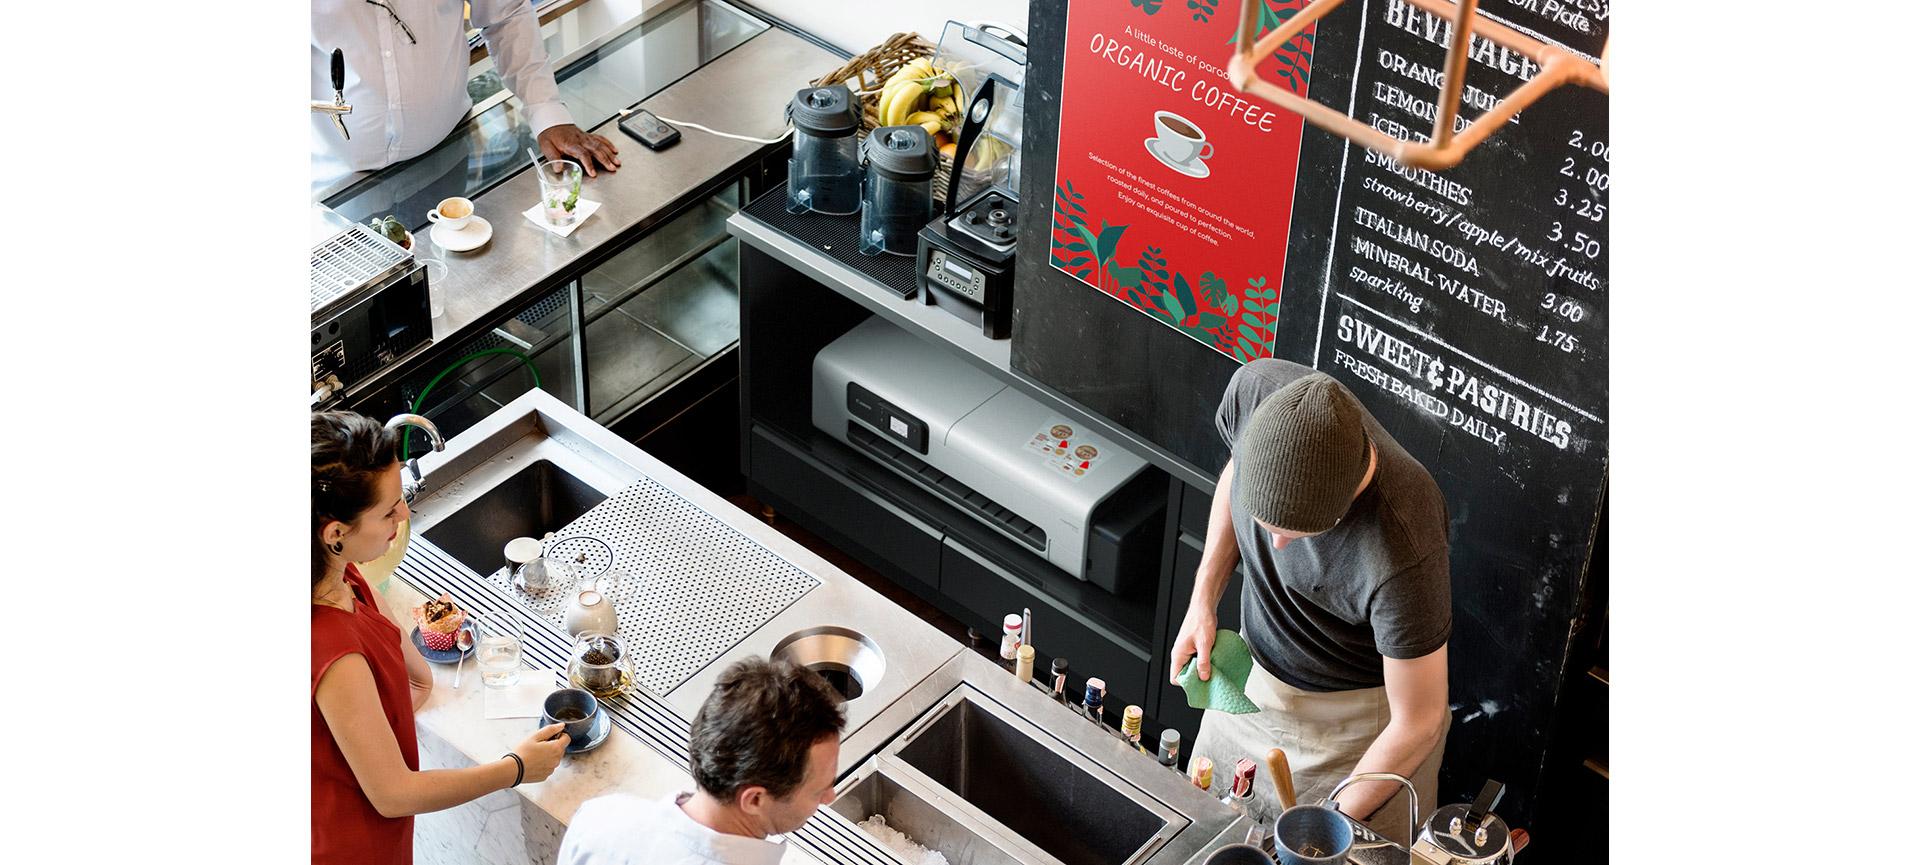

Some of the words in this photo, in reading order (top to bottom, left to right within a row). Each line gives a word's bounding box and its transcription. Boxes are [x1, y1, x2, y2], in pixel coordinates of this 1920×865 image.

[1386, 0, 1541, 82] BEVAGE
[1541, 0, 1590, 32] Plate
[1125, 25, 1133, 36] A
[1134, 28, 1156, 47] little
[1158, 41, 1184, 60] taste
[1186, 55, 1198, 65] of
[1198, 61, 1231, 81] parad
[1379, 50, 1447, 90] ORANG
[1089, 33, 1186, 92] ORGANIC
[1191, 80, 1276, 132] COFFEE
[1374, 82, 1476, 134] LEMOND
[1370, 113, 1409, 142] ICED
[1088, 152, 1118, 172] Selection
[1119, 167, 1126, 175] of
[1126, 170, 1138, 182] the
[1138, 176, 1156, 190] finest
[1156, 185, 1180, 202] coffees
[1181, 197, 1197, 210] from
[1197, 206, 1222, 223] around
[1223, 217, 1235, 229] the
[1364, 147, 1473, 206] SMOOTHIES
[1559, 157, 1609, 191] 2.00
[1107, 174, 1133, 191] roasted
[1133, 186, 1150, 201] daily,
[1151, 196, 1164, 207] and
[1164, 203, 1189, 219] poured
[1189, 214, 1197, 223] to
[1197, 219, 1233, 241] perfection.
[1118, 191, 1136, 208] Enjoy
[1136, 202, 1146, 210] an
[1146, 206, 1175, 225] exquisite
[1176, 221, 1188, 231] cup
[1189, 226, 1197, 235] of
[1197, 230, 1219, 247] coffee.
[1553, 188, 1607, 222] 3.25
[1355, 206, 1429, 252] ITALIAN
[1430, 240, 1480, 277] SODA
[1546, 221, 1600, 259] 3.50
[1349, 266, 1424, 314] sparkling
[1354, 236, 1434, 287] MINERAL
[1438, 273, 1507, 322] WATER
[1546, 257, 1600, 291] fruits
[1541, 293, 1584, 322] 3.00
[1536, 325, 1580, 353] 1.75
[1334, 348, 1388, 390] FRESH
[1388, 377, 1449, 419] BAKED
[1450, 407, 1508, 448] DAILY
[1446, 365, 1573, 450] PASTRIES
